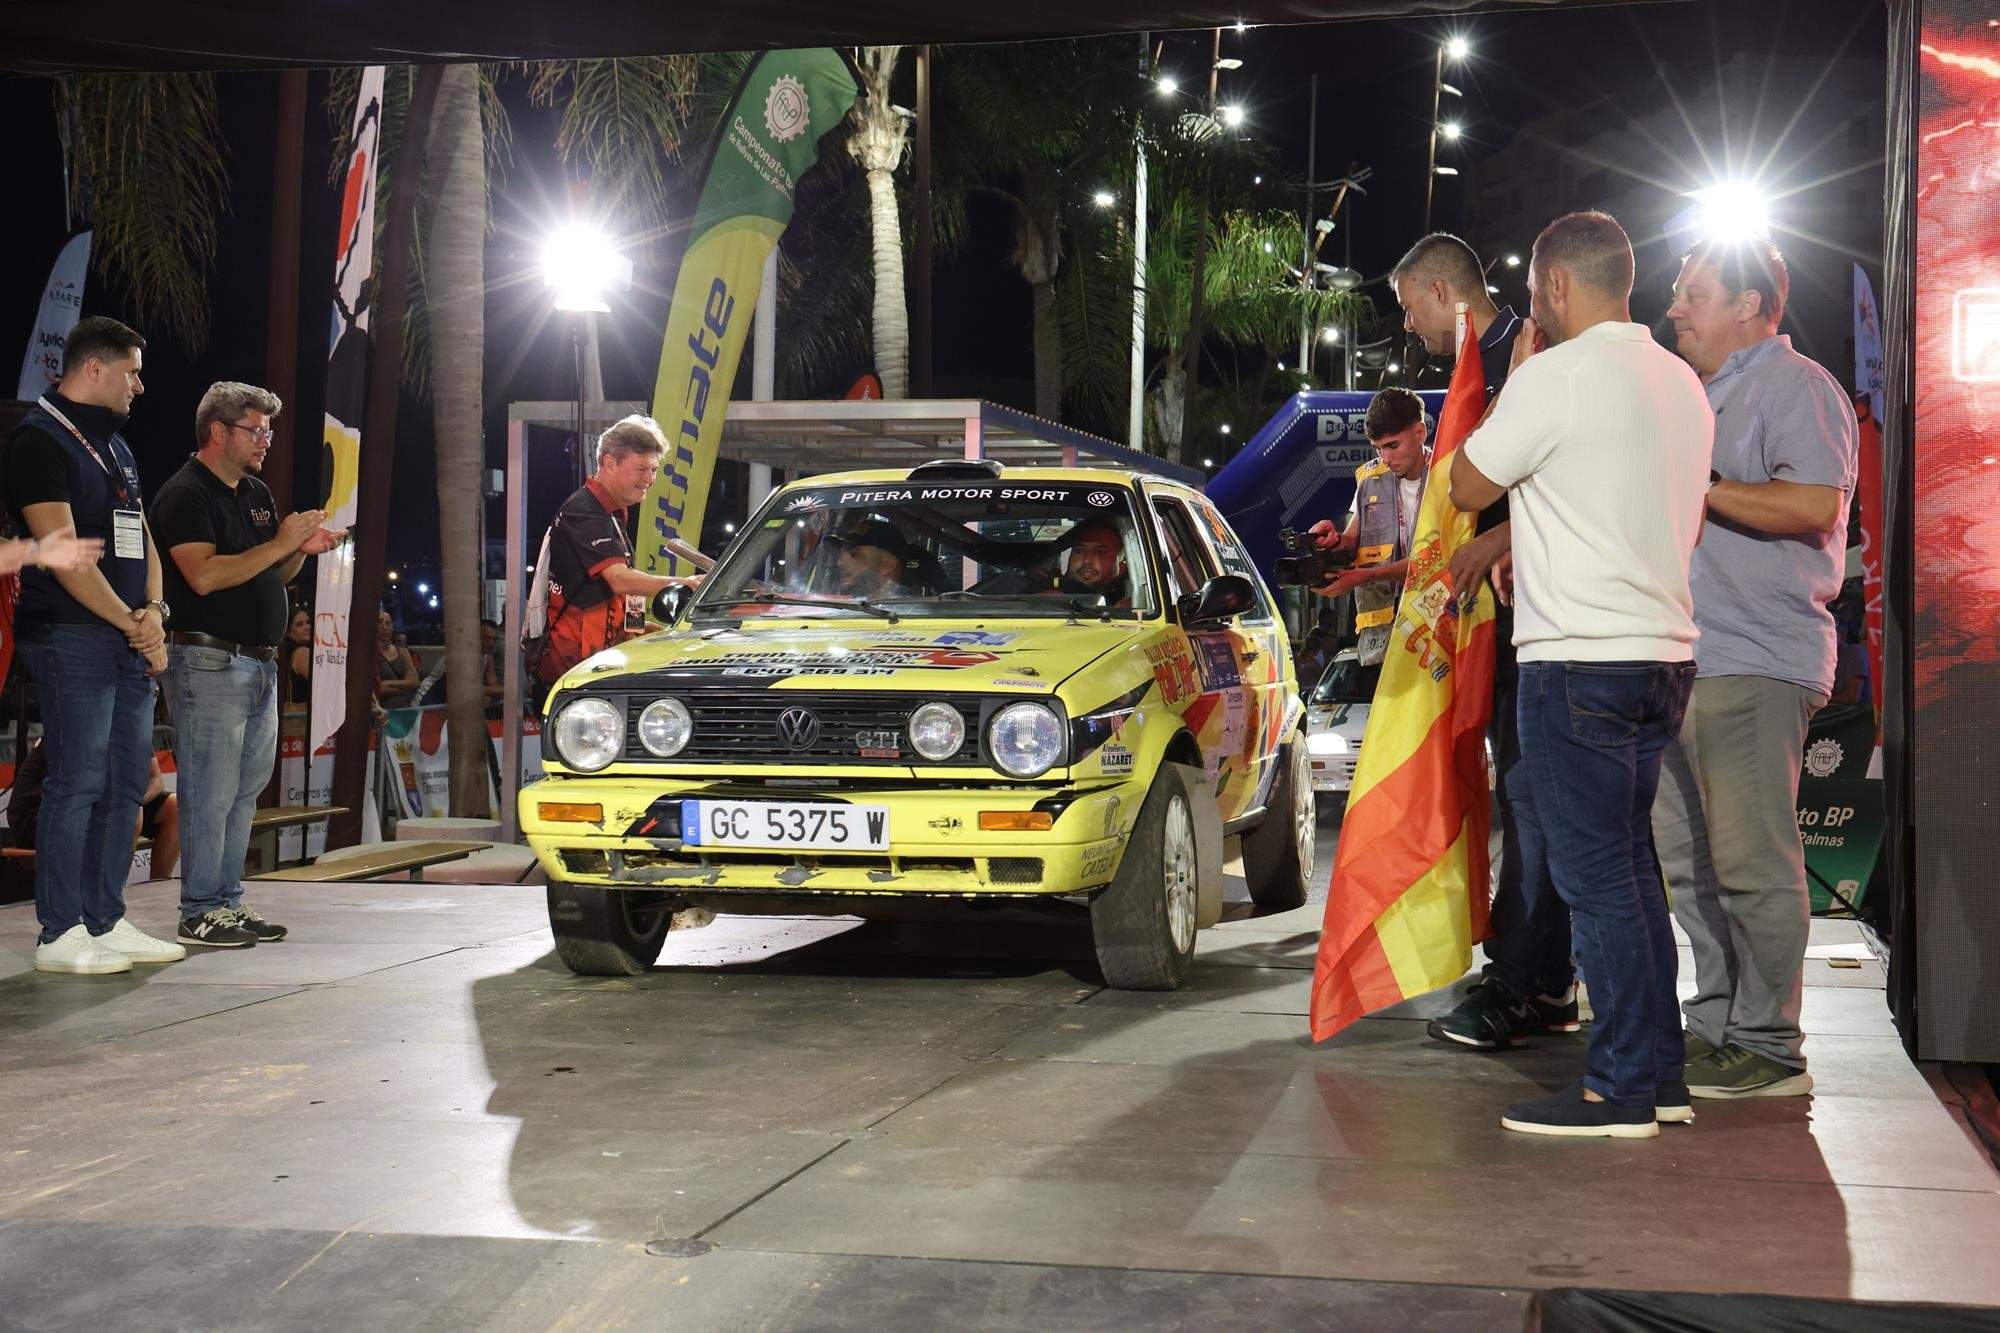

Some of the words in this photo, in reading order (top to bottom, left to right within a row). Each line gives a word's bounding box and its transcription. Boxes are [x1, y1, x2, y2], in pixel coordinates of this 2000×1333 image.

[734, 116, 786, 178] Campeonato
[760, 168, 771, 182] Las
[840, 490, 912, 503] PITERA
[921, 488, 993, 499] MOTOR
[1000, 488, 1069, 501] SPORT
[856, 731, 900, 749] GTI
[1101, 754, 1132, 767] NAZARET
[287, 786, 321, 801] Cenros
[1823, 806, 1855, 828] BP
[687, 826, 696, 837] E
[711, 807, 749, 840] GC
[767, 809, 848, 843] 5375
[866, 811, 885, 845] W
